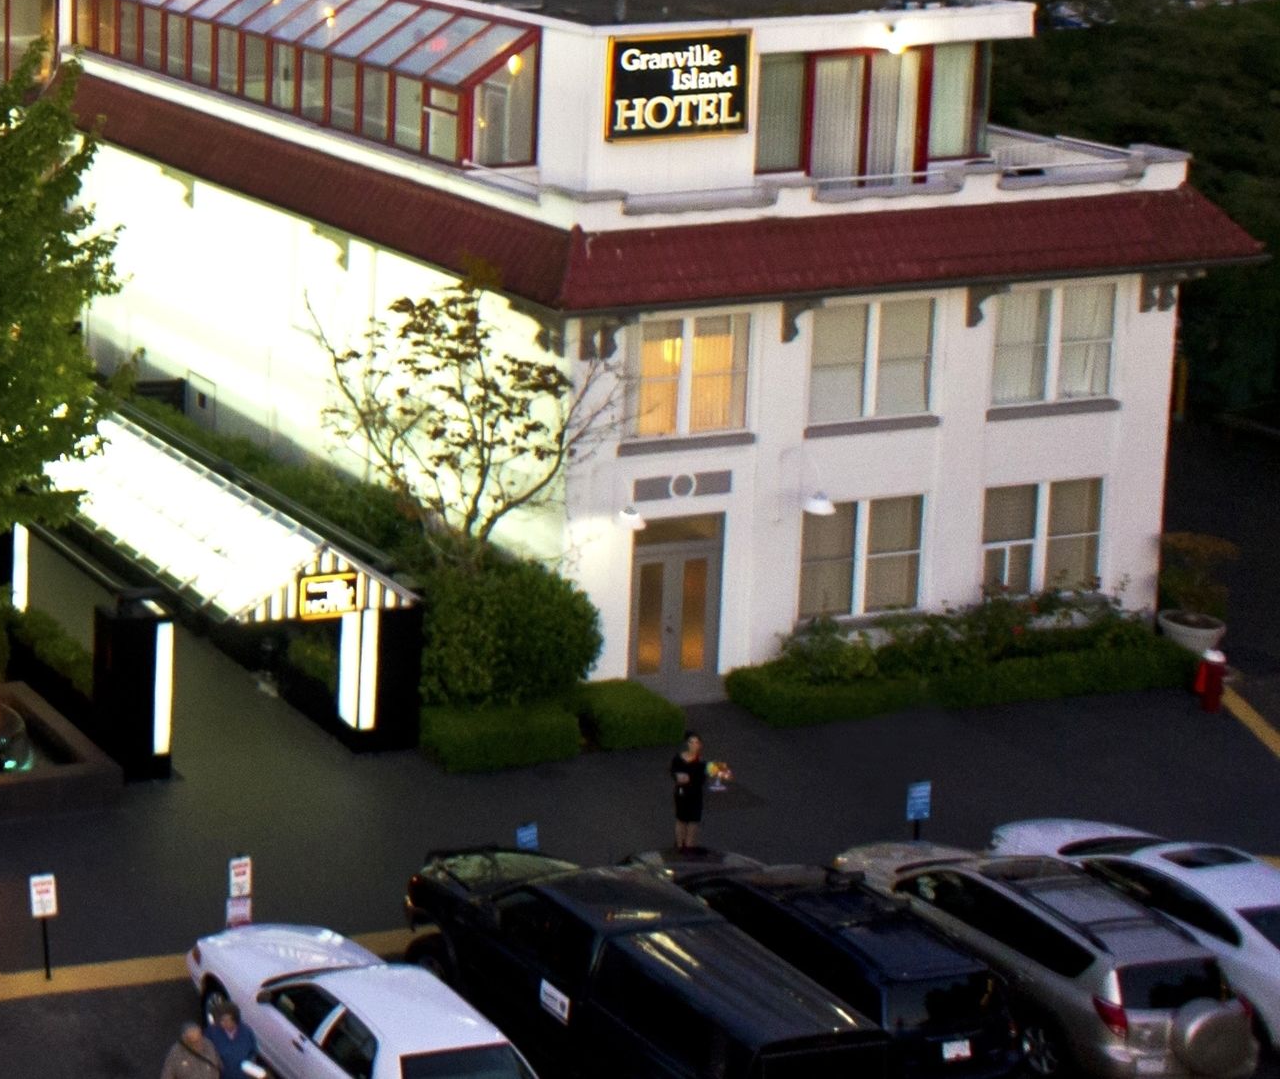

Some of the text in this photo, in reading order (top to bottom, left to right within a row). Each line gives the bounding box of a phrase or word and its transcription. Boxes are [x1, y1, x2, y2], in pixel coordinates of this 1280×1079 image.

[621, 44, 722, 71] Granville
[671, 65, 738, 90] Island
[614, 92, 741, 130] HOTEL
